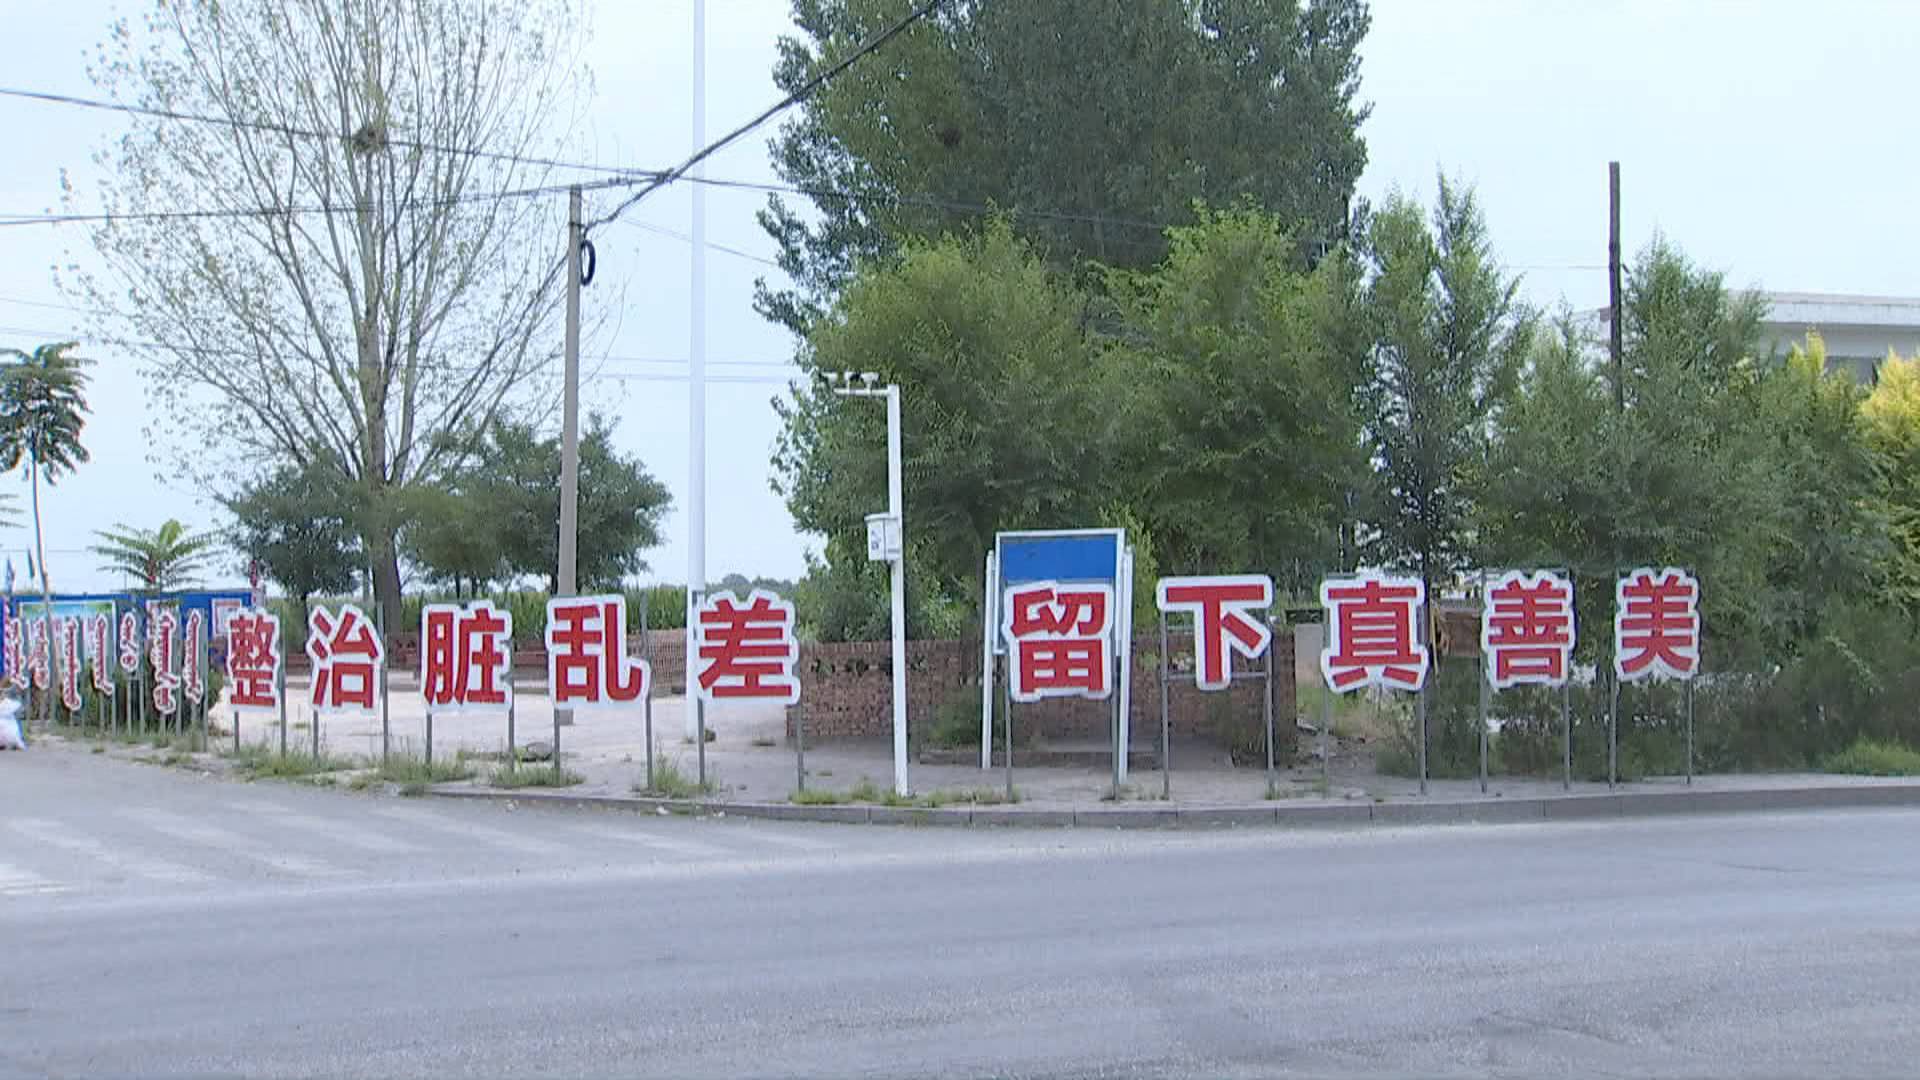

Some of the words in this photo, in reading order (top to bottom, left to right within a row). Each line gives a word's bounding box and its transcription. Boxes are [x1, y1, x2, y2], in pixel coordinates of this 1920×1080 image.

[230, 598, 792, 708] 整治脏乱差
[1011, 574, 1694, 693] 留下真善美
